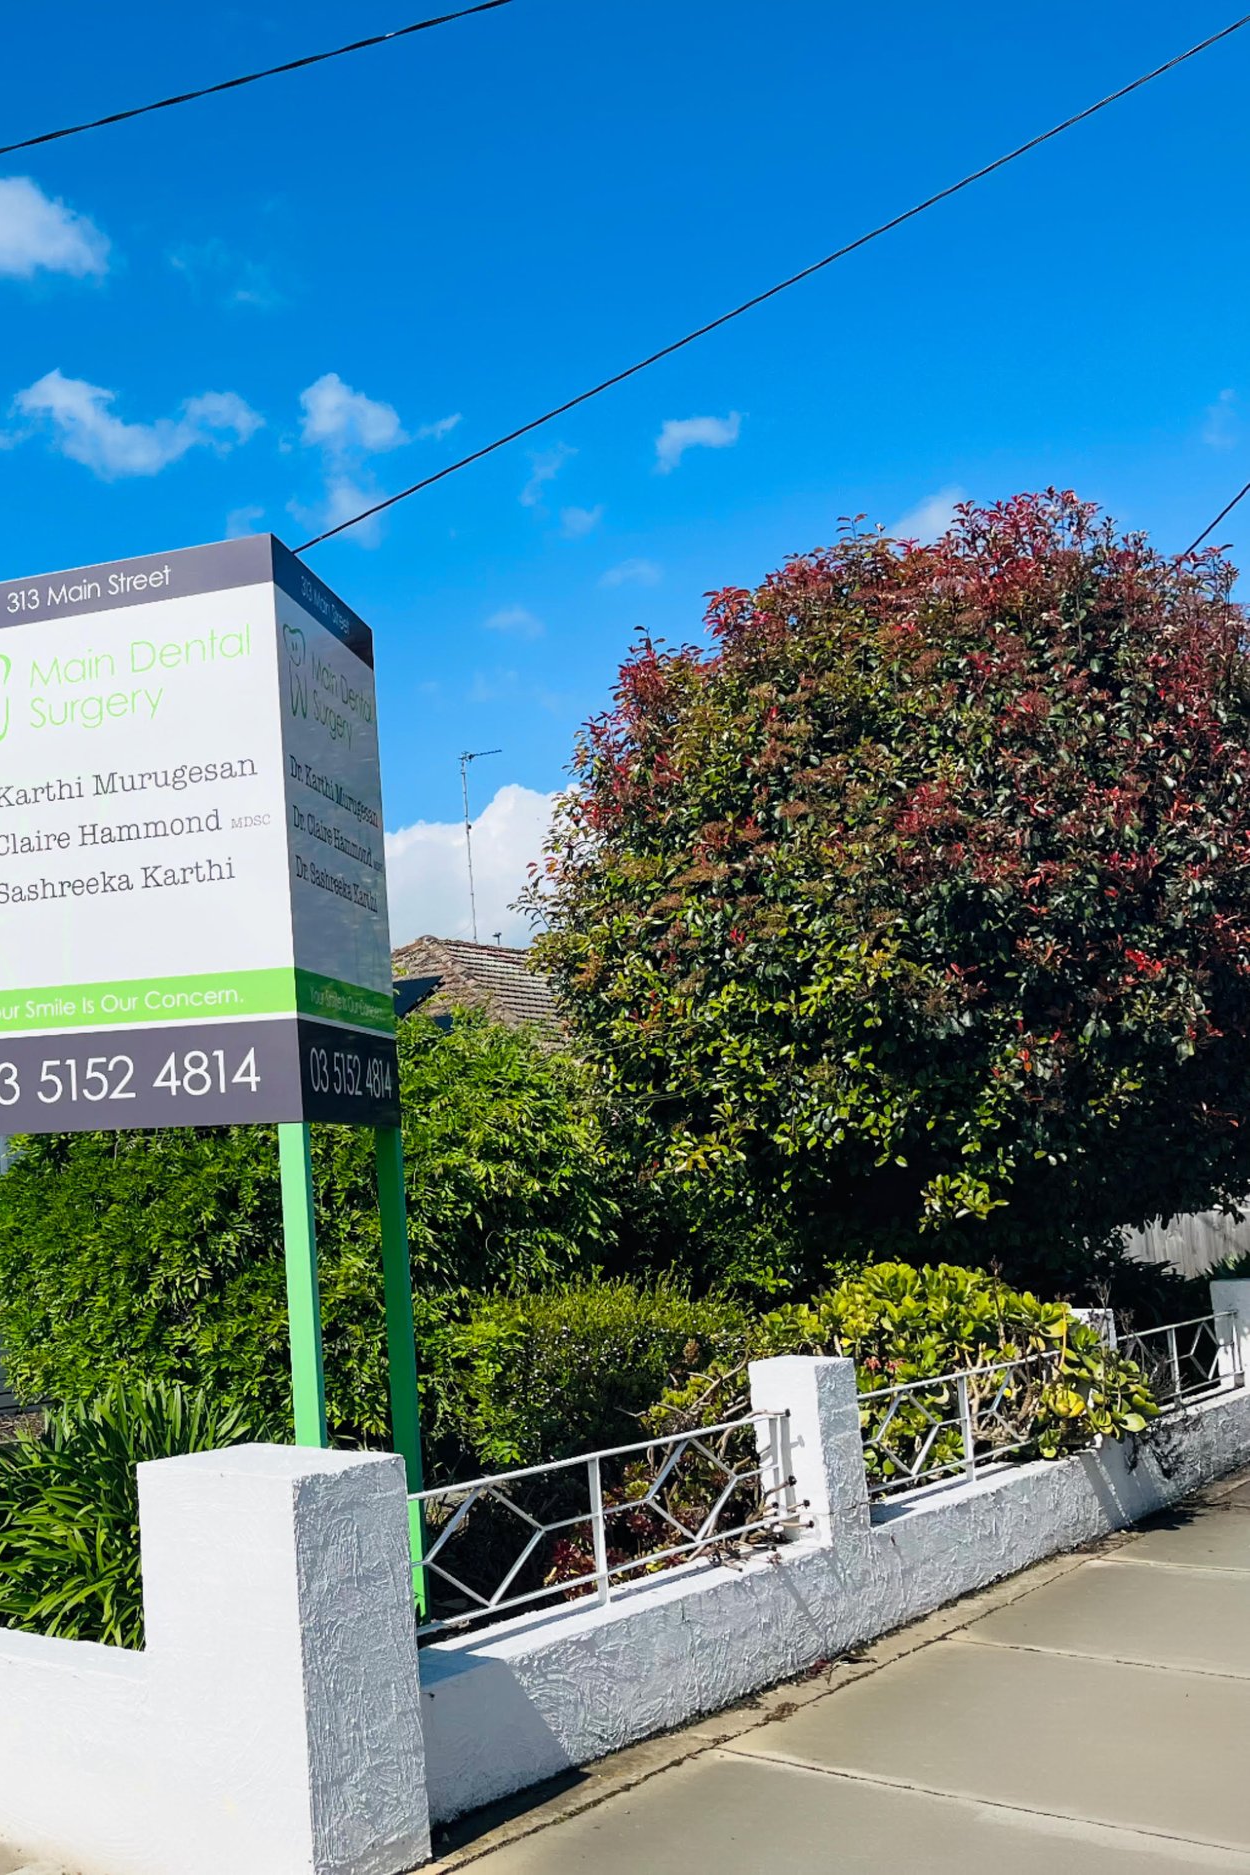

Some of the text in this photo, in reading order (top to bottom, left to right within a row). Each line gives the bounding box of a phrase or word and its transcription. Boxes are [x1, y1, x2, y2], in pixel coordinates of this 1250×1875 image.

[6, 564, 172, 614] 313 Main Street
[30, 624, 252, 688] Main Dental
[30, 687, 164, 729] Surgery
[311, 651, 373, 723] Main Dental
[313, 689, 353, 751] Surgery
[92, 757, 258, 797] Murugesan
[289, 754, 380, 829] Dr. Karthi Murugesan
[78, 809, 222, 847] Hammond
[231, 813, 271, 829] MDSC
[292, 804, 373, 867] Dr. Claire Hammond
[141, 856, 236, 889] Karthi
[25, 997, 76, 1020] Smile
[81, 995, 95, 1015] Is
[101, 993, 140, 1013] Our
[145, 986, 244, 1010] Concern.
[37, 1055, 137, 1104] 5152
[153, 1047, 261, 1097] 4814
[310, 1047, 392, 1099] 03 5152 4814
